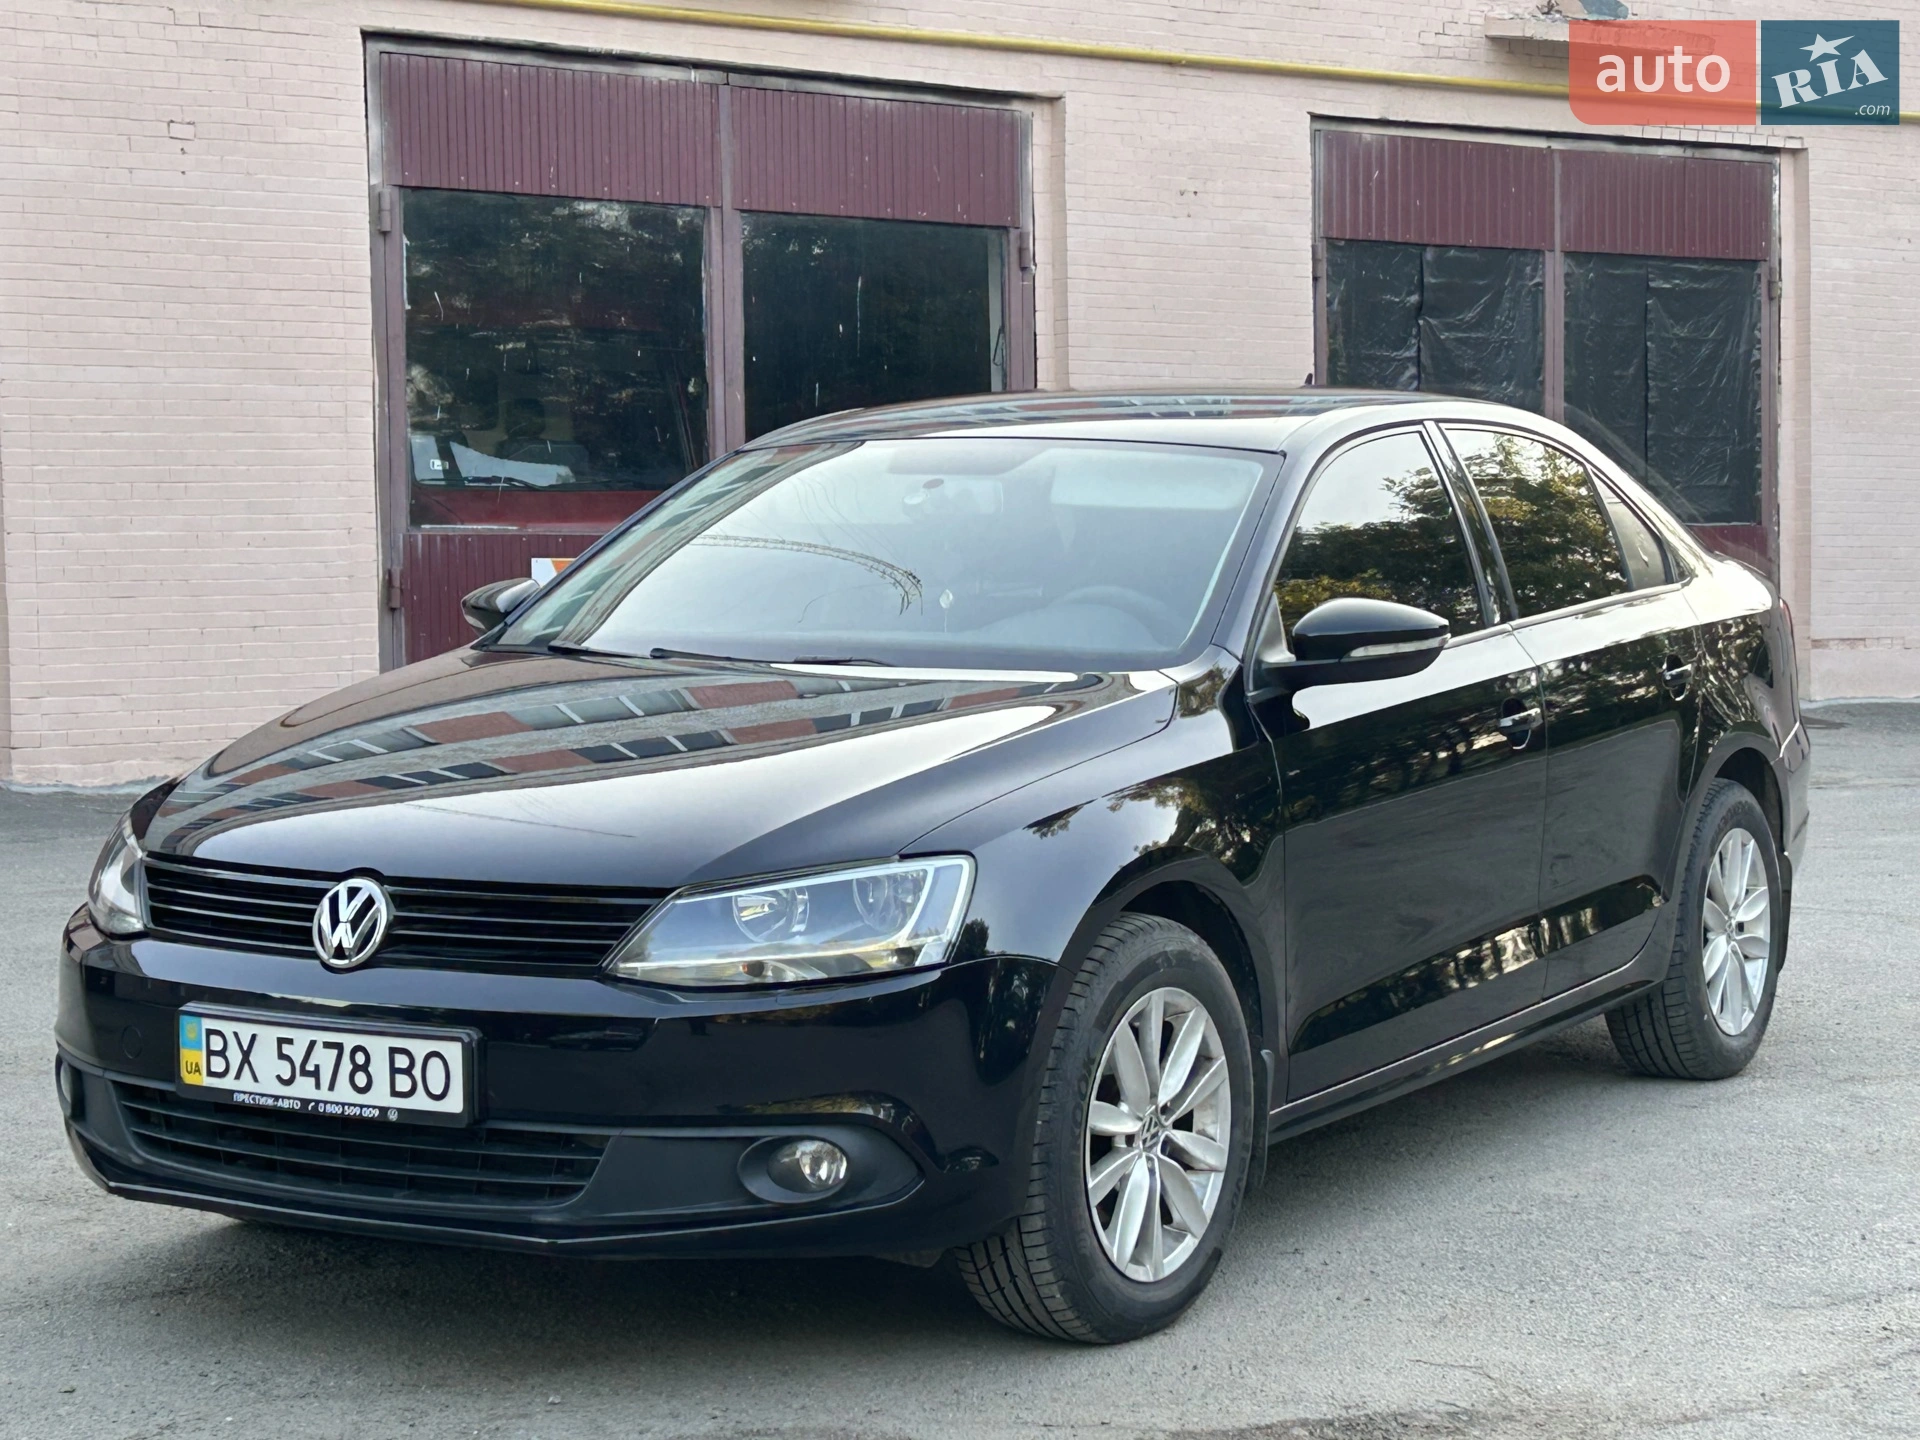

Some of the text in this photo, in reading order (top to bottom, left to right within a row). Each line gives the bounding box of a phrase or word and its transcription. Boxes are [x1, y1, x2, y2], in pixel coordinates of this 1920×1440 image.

[185, 1059, 202, 1077] UA
[205, 1028, 260, 1083] BX
[275, 1036, 373, 1095] 5478
